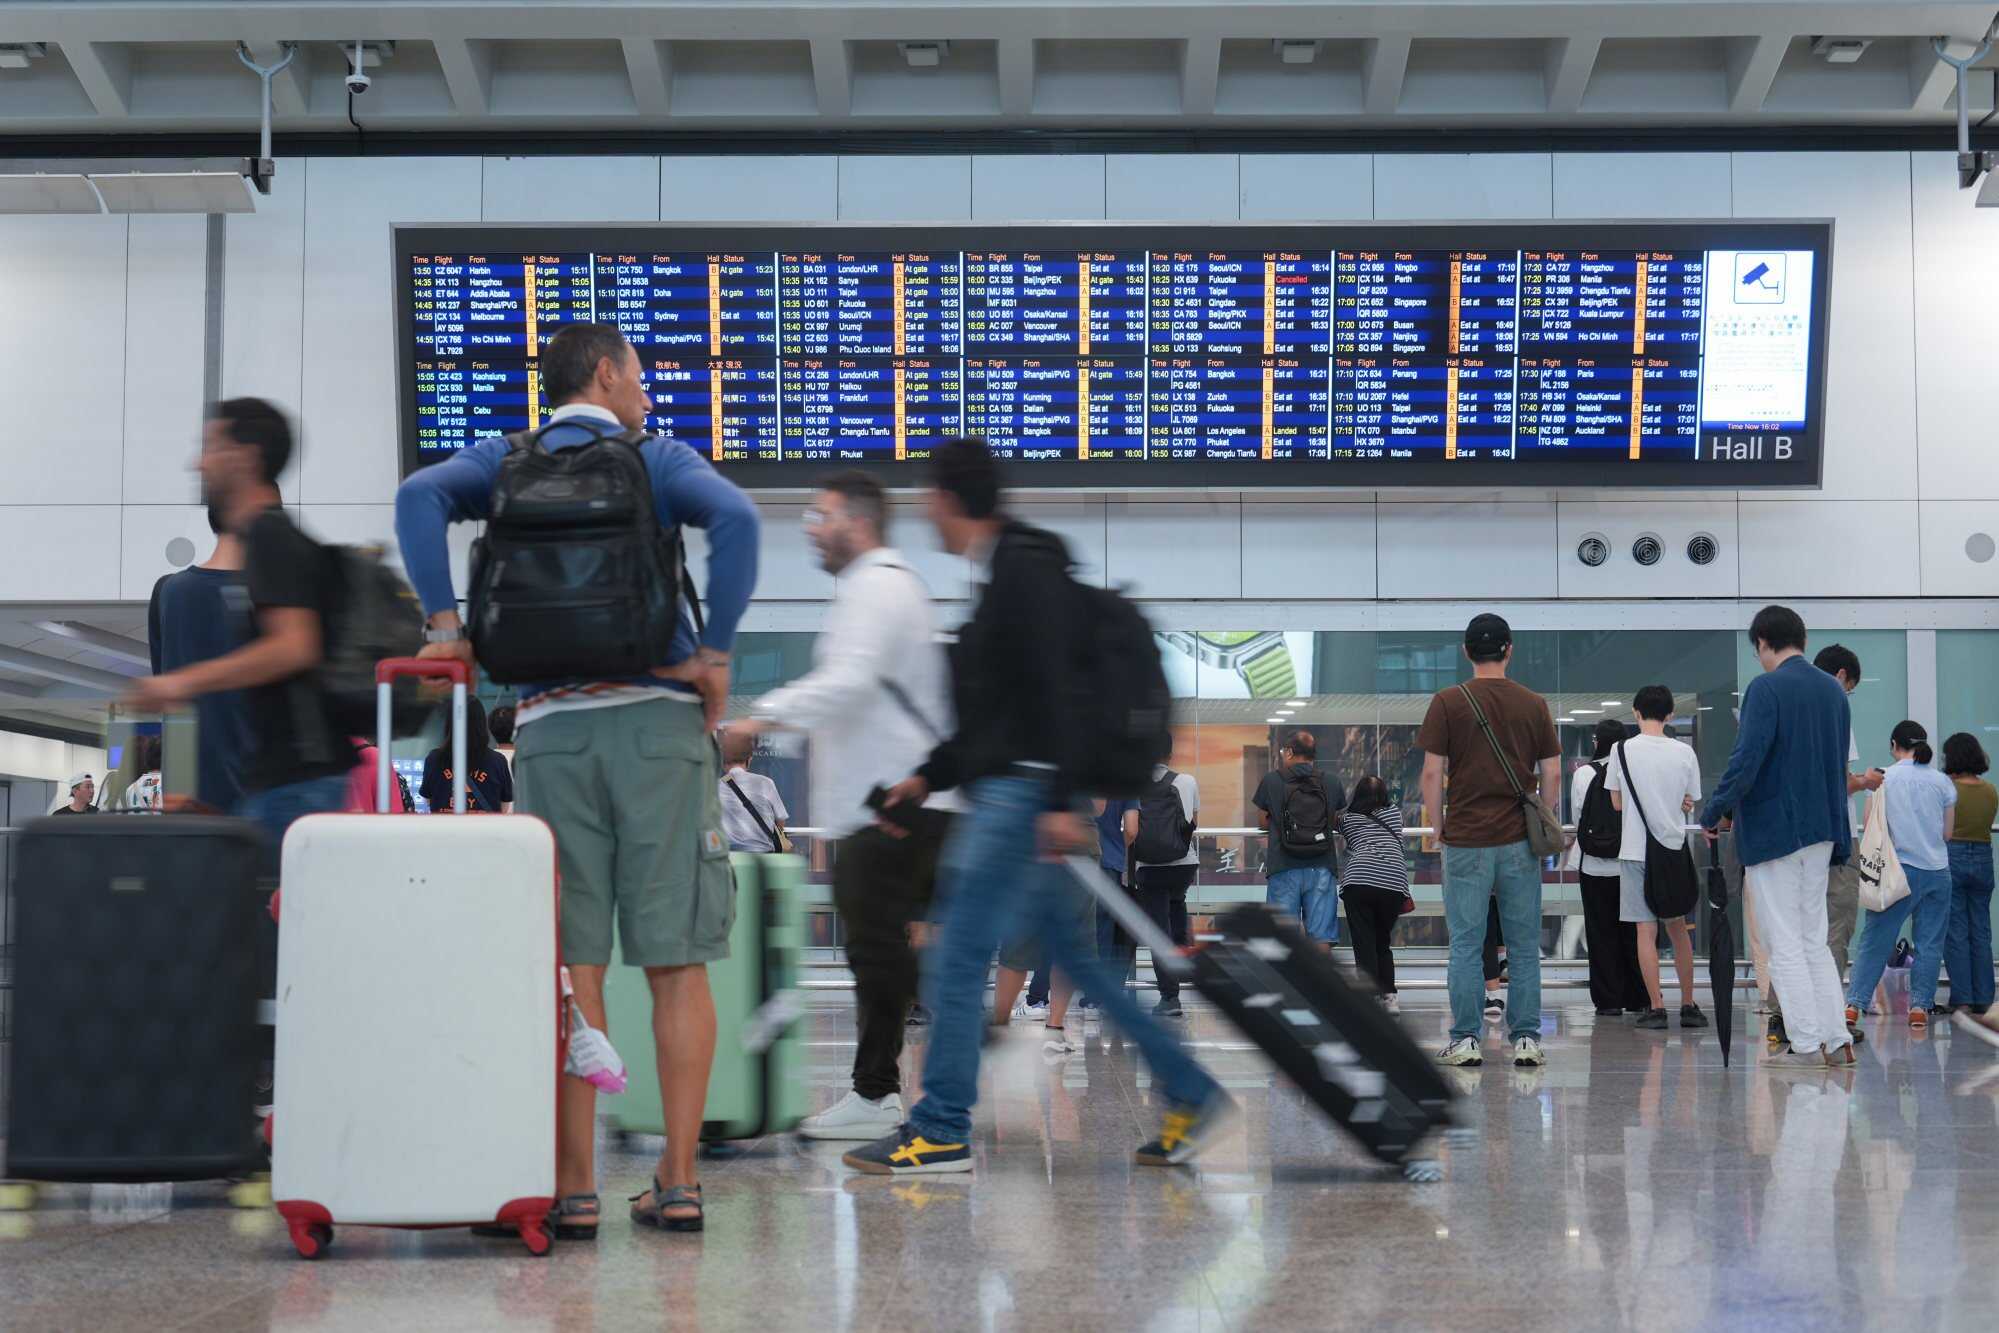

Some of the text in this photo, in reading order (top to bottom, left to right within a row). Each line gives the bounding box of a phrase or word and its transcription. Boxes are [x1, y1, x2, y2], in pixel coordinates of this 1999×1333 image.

[435, 256, 452, 265] Flight
[523, 256, 535, 264] Hall
[619, 256, 636, 264] Flight
[804, 255, 821, 263] Flight
[838, 254, 854, 262] From
[989, 254, 1007, 263] Flight
[1024, 253, 1040, 261] From
[1095, 253, 1115, 261] Status
[1175, 253, 1192, 262] Flight
[1209, 253, 1225, 261] From
[1264, 253, 1275, 261] Hall
[1360, 253, 1377, 262] Flight
[1547, 253, 1564, 262] Flight
[1636, 253, 1648, 261] Hall
[653, 266, 681, 275] Bangkok
[838, 265, 878, 273] London/LHR
[1395, 264, 1418, 273] Ningbo
[1581, 264, 1614, 273] Hangzhou
[470, 278, 502, 287] Hangzhou
[839, 277, 858, 286] Sanya
[1024, 276, 1061, 285] Beijing/PEK
[1209, 275, 1236, 283] Fukuoka
[838, 288, 857, 297] Taipei
[1024, 288, 1056, 297] Hangzhou
[1209, 299, 1236, 308] Qingdao
[1394, 298, 1426, 307] Singapore
[655, 312, 678, 321] Sydney
[1024, 310, 1067, 318] Osaka/Kansai
[1599, 310, 1624, 319] Lumpur
[839, 323, 862, 332] Urumqi
[655, 335, 702, 344] Shanghai/PVG
[840, 334, 862, 343] Urumqi
[1208, 345, 1241, 353] Kaohsiung
[438, 362, 456, 371] Flight
[805, 361, 822, 369] Flight
[989, 360, 1006, 369] Flight
[1173, 360, 1190, 368] Flight
[1278, 359, 1298, 367] Status
[1358, 359, 1375, 368] Flight
[1543, 359, 1560, 368] Flight
[840, 371, 879, 379] London/LHR
[1208, 370, 1235, 379] Bangkok
[1393, 370, 1417, 379] Penang
[1024, 393, 1051, 402] Kunming
[1208, 404, 1234, 412] Fukuoka
[1576, 415, 1622, 424] Shanghai/SHA
[475, 429, 503, 439] Bangkok
[840, 428, 869, 437] Chengdu
[1024, 427, 1051, 436] Bangkok
[1220, 427, 1245, 436] Angeles
[1207, 438, 1229, 446] Phuket
[1712, 436, 1793, 460] Hall B
[906, 450, 929, 458] Landed
[1024, 450, 1061, 459] Beijing/PEK
[1207, 450, 1235, 458] Chengdu
